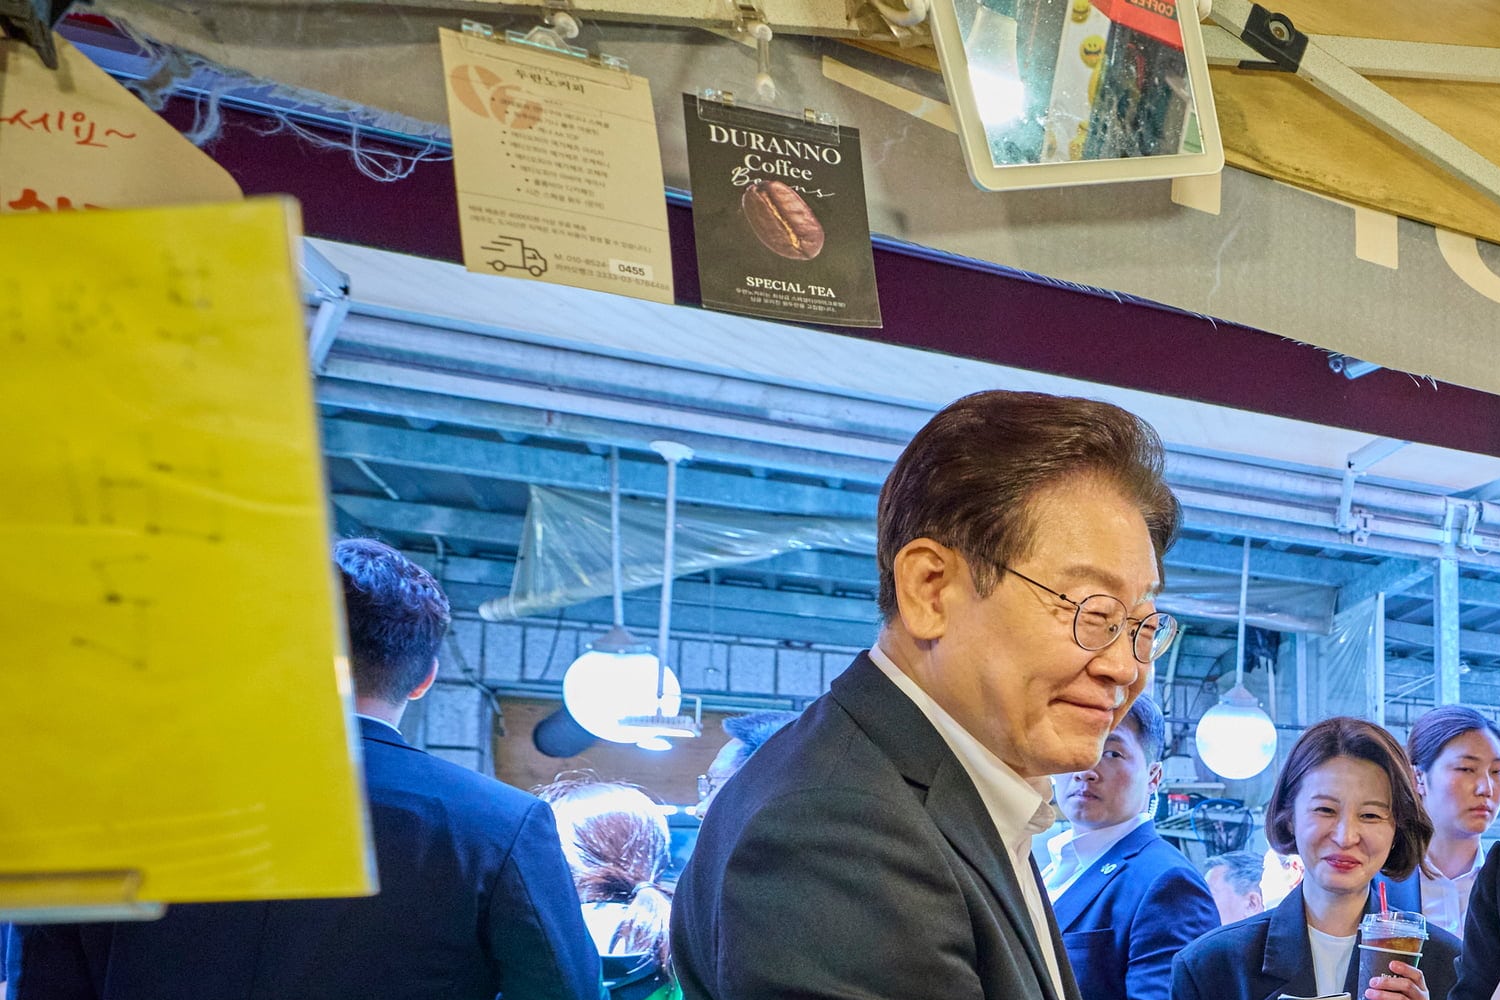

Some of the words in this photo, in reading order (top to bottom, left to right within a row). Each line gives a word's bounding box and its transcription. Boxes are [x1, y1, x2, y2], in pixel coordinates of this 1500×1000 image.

[516, 69, 585, 94] 두란노커피
[709, 124, 842, 165] DURANNO
[744, 153, 813, 180] Coffee
[731, 165, 836, 198] Bens
[618, 263, 645, 276] 0455
[746, 275, 806, 294] SPECIAL
[808, 284, 836, 298] TEA
